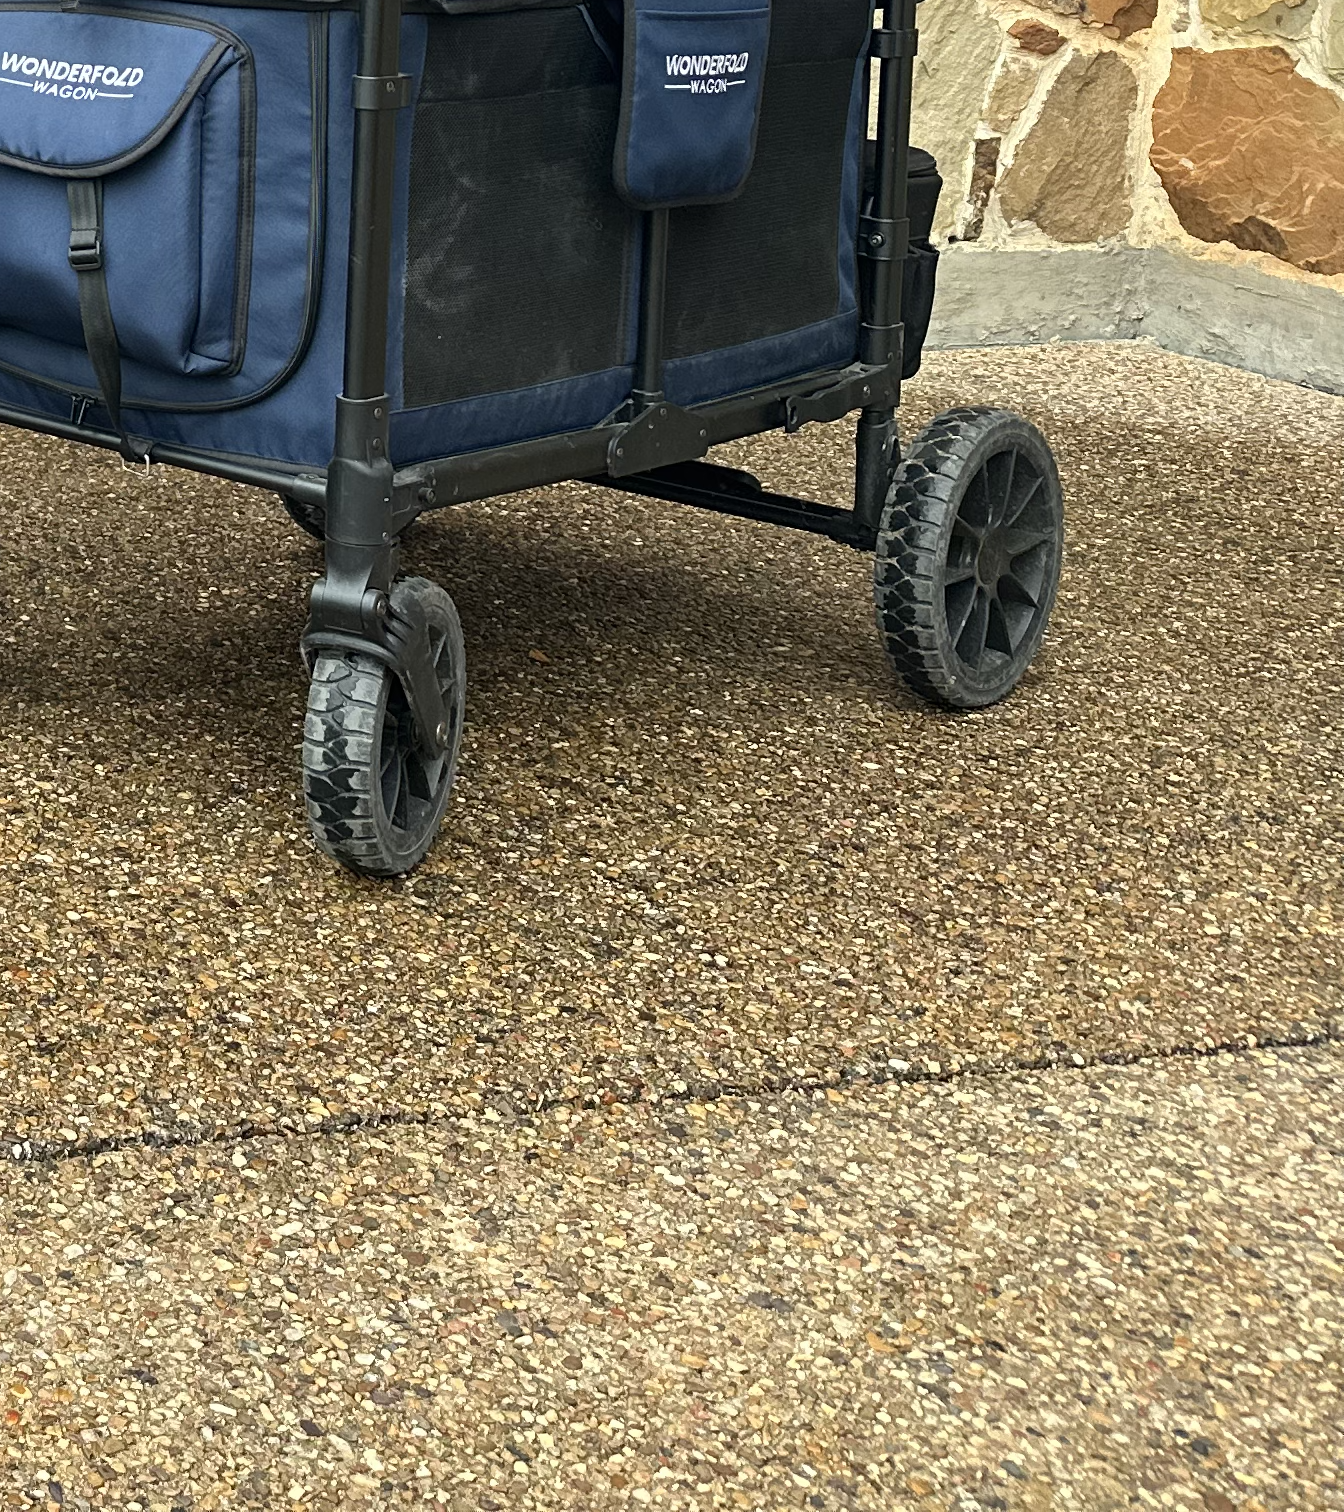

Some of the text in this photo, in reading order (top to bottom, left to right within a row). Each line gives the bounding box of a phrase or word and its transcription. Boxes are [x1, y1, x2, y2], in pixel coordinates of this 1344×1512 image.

[1, 51, 144, 87] WONDERFOLD
[666, 52, 749, 76] WONDERFOLD
[32, 80, 98, 101] WAGON
[690, 78, 728, 94] WAGON
